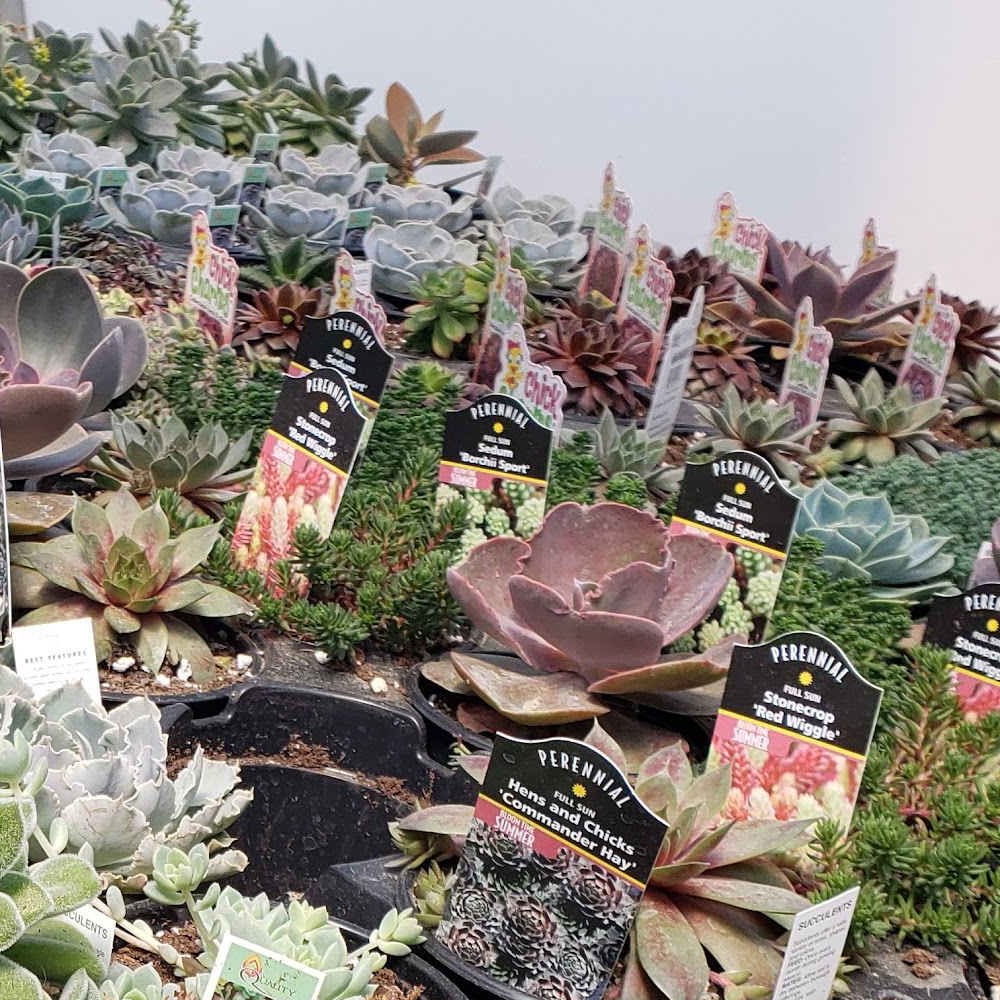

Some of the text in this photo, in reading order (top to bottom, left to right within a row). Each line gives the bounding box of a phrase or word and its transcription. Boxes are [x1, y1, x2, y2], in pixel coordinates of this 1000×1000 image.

[326, 317, 376, 350] PERENNIAL
[325, 353, 357, 375] Sedum
[306, 377, 351, 413] PERENNIAL
[525, 370, 562, 420] Chick
[295, 415, 337, 447] Stonecrop
[470, 401, 530, 429] PERENNIAL
[288, 426, 307, 444] 'Red
[305, 436, 337, 460] Wiggle'
[478, 442, 514, 458] Sedum
[459, 451, 530, 475] 'Borchii Sport'
[712, 459, 776, 493] PERENNIAL
[694, 509, 735, 532] 'Borchii
[735, 523, 771, 543] Sport'
[715, 501, 754, 524] Sedum
[24, 650, 87, 664] BEST FEATURES
[771, 643, 850, 684] PERENNIAL
[763, 690, 836, 725] Stonecrop
[783, 684, 822, 704] FULL SUN
[753, 704, 841, 742] 'Red Wiggle'
[732, 727, 770, 752] SUMMER
[537, 749, 631, 809] PERENNIAL
[507, 777, 636, 856] Hens and Chicks
[553, 790, 597, 819] FULL SUN
[493, 815, 535, 848] SUMMER
[499, 809, 535, 836] BLOOM TIME
[499, 788, 637, 872] 'Commander Hay'
[64, 911, 108, 939] CULENTS
[797, 900, 852, 932] SUCCULENTS
